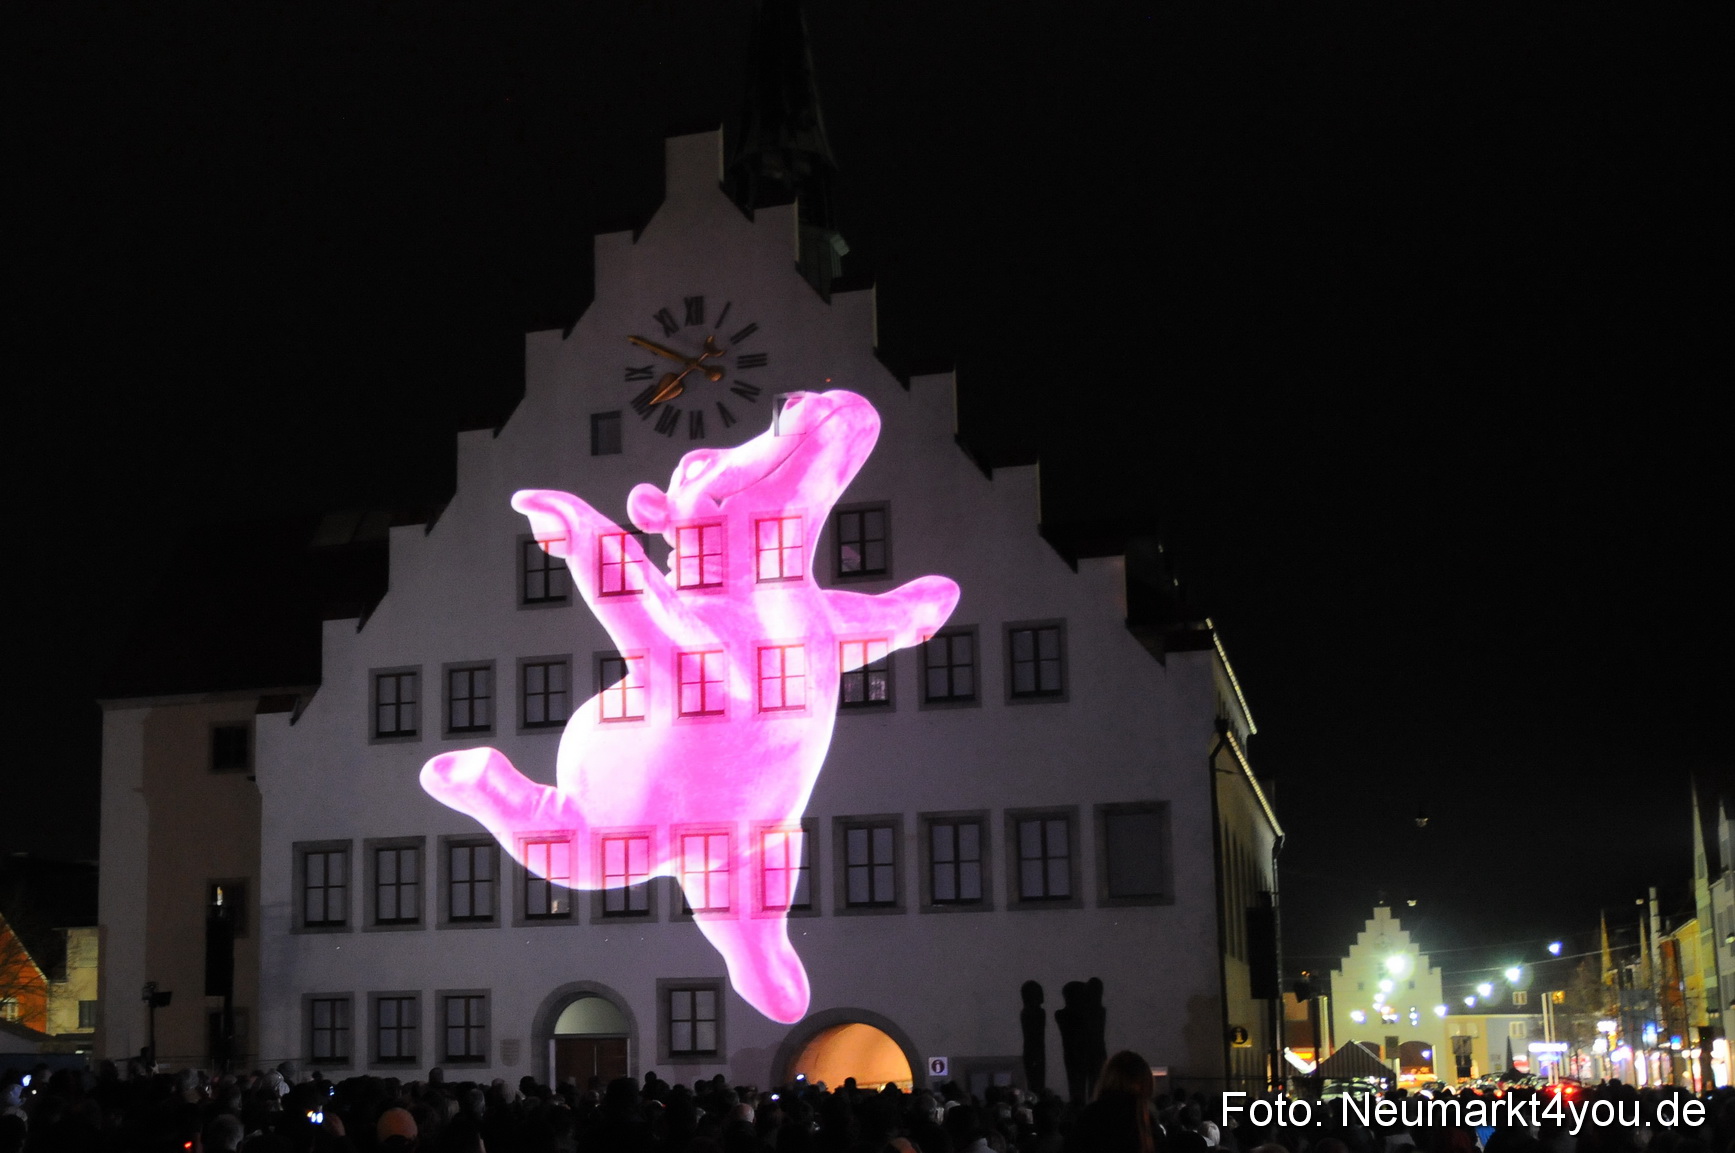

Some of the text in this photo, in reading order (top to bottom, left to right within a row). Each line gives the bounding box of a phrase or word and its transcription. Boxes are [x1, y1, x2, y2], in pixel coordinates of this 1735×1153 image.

[653, 307, 679, 338] XI
[684, 295, 704, 326] XII
[730, 322, 759, 345] II
[624, 365, 654, 382] IX
[737, 352, 767, 369] III
[730, 380, 761, 403] IV
[654, 404, 682, 438] VII
[689, 410, 704, 440] VI
[716, 401, 737, 428] V
